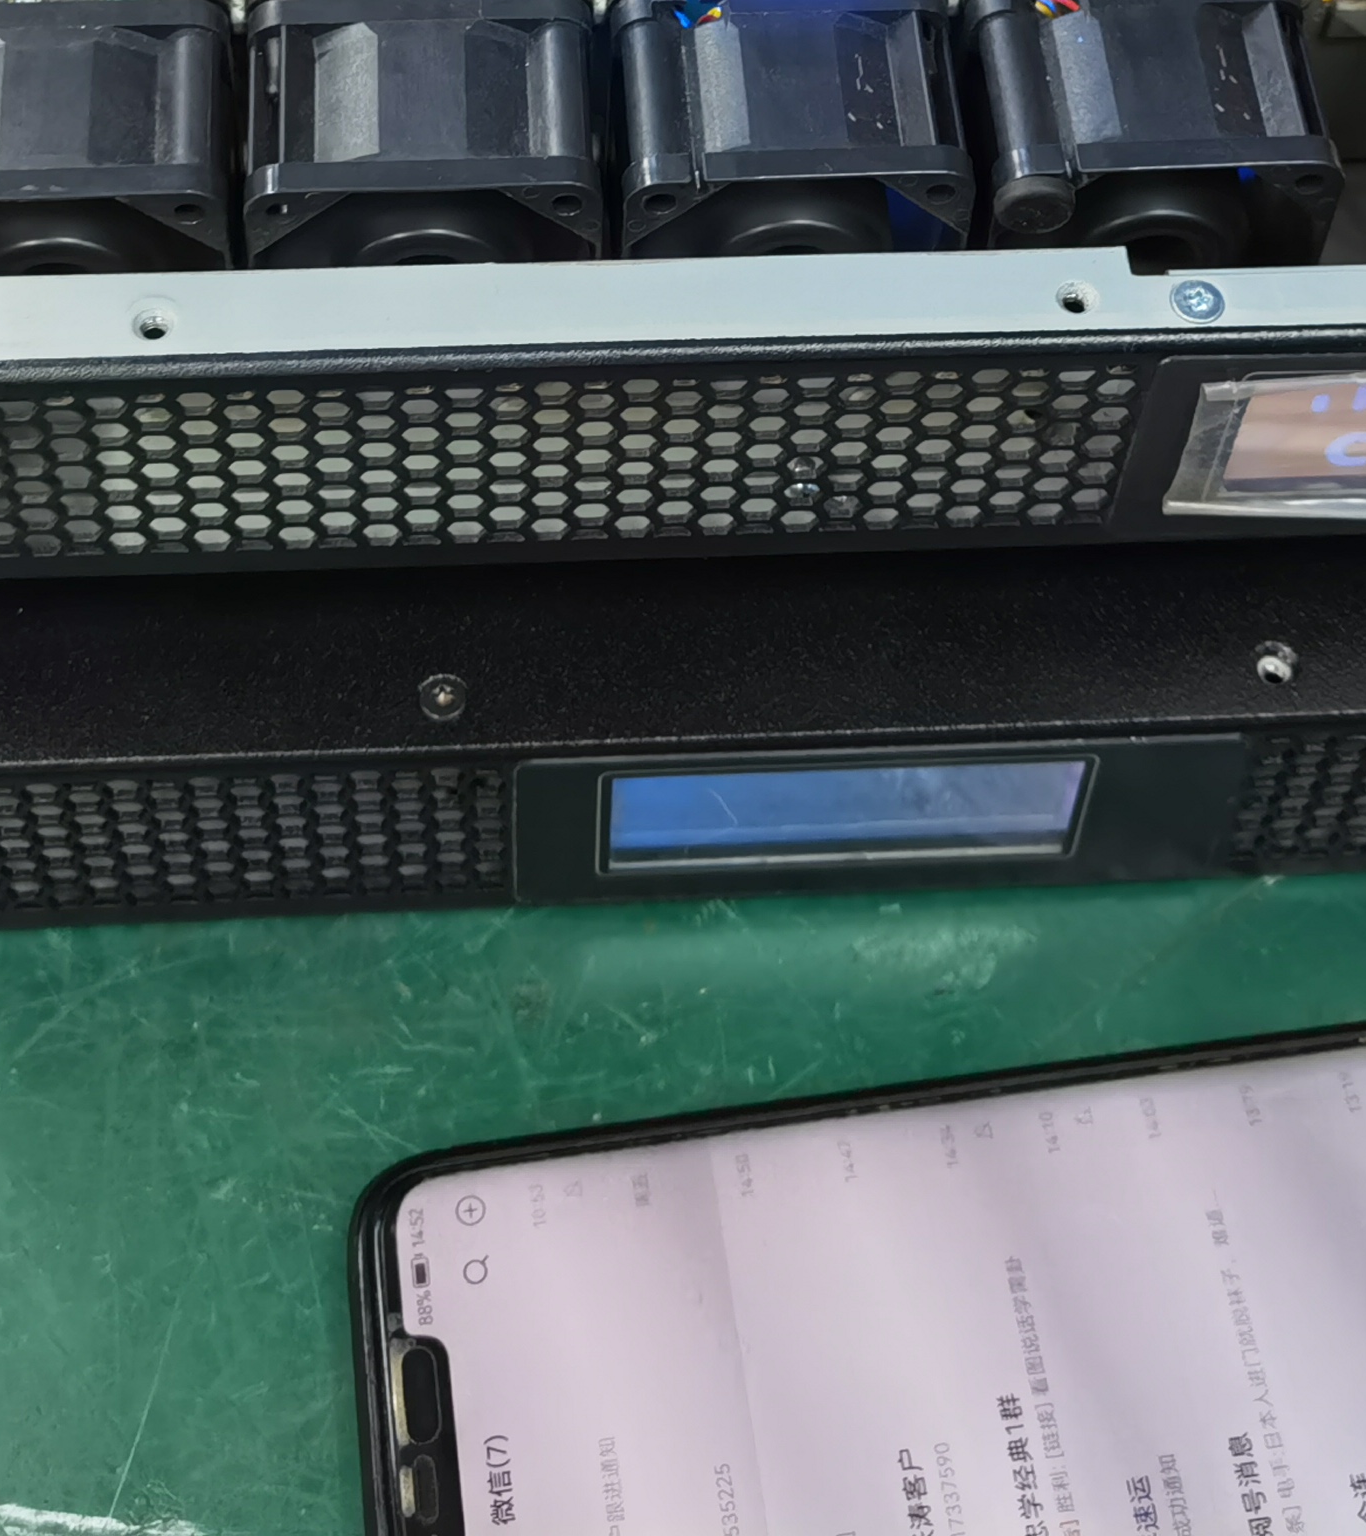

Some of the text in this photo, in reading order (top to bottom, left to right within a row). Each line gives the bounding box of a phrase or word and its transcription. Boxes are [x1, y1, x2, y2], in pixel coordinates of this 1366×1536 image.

[411, 1209, 434, 1326] 88% 14:52
[1035, 1402, 1064, 1459] [链接]
[482, 1433, 516, 1526] 微信(7)
[1126, 1476, 1159, 1536] 速运
[1158, 1453, 1192, 1536] 成功通知
